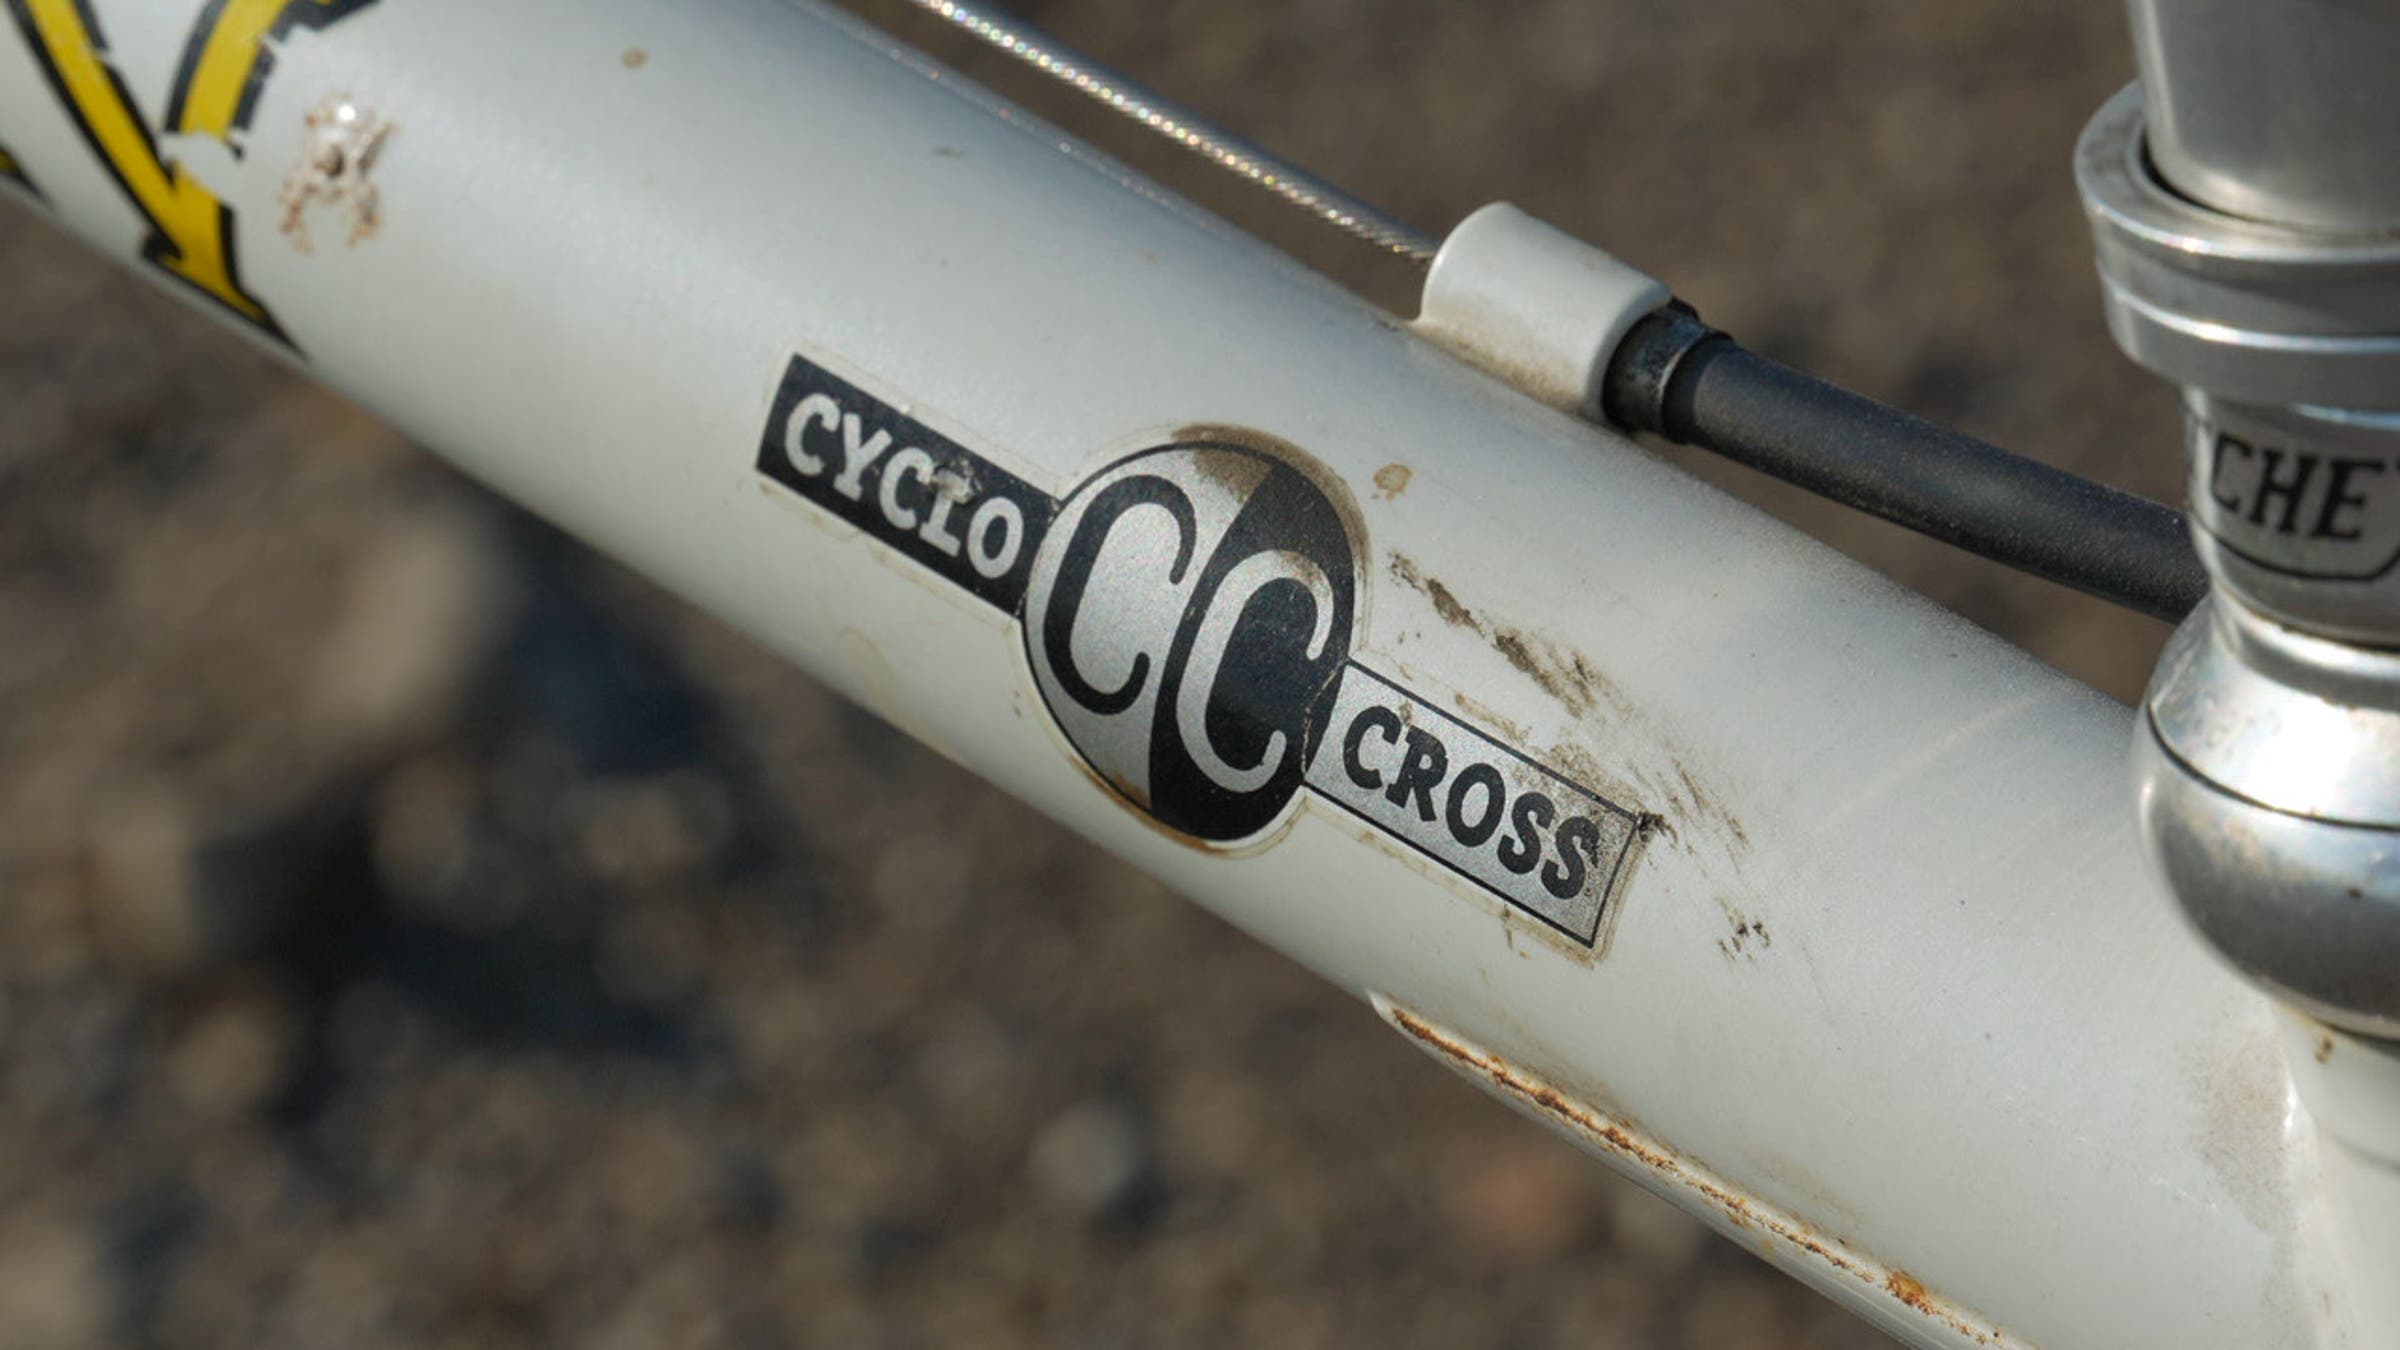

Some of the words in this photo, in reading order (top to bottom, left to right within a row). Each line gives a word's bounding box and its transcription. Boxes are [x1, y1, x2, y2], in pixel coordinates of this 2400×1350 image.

[784, 393, 1024, 579] CYCLO
[2211, 430, 2399, 543] CHE
[1343, 705, 1600, 900] CROSS
